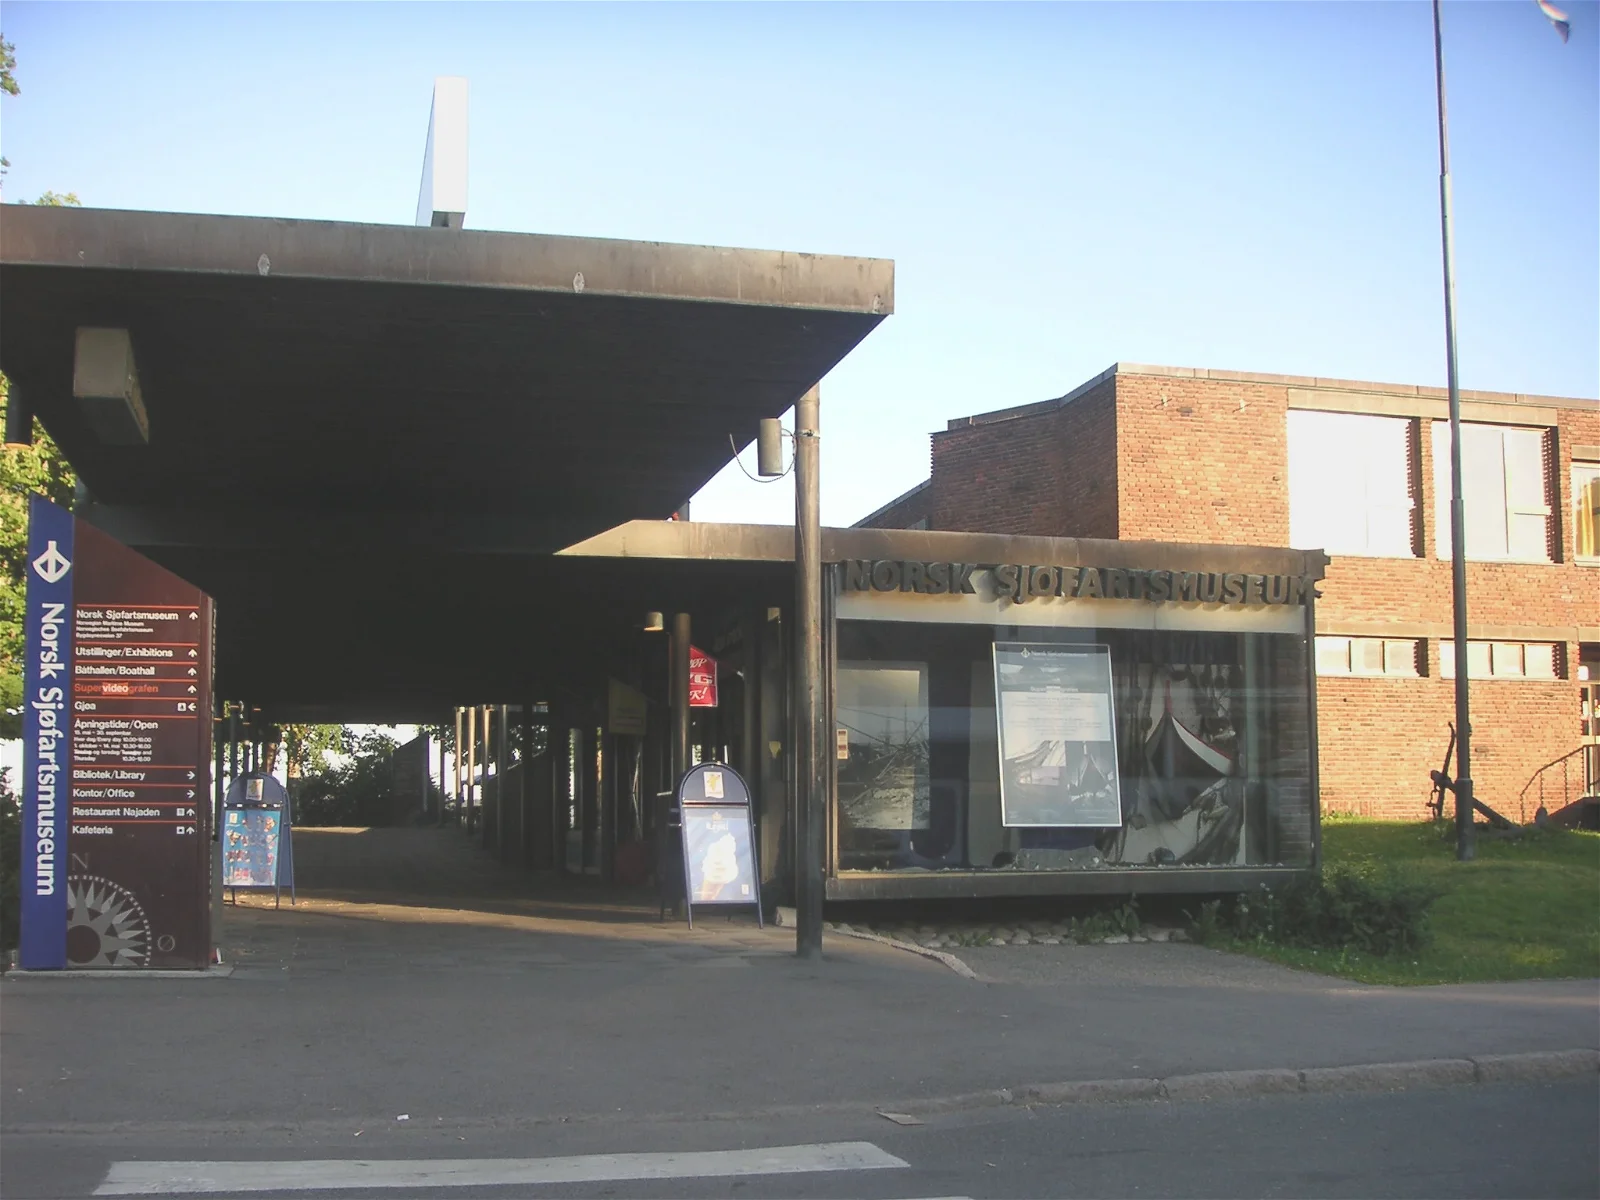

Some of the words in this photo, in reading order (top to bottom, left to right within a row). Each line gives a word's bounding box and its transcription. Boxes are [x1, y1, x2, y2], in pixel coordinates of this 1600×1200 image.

[845, 559, 977, 594] NORSK
[76, 610, 103, 619] Norsk
[40, 603, 65, 679] Norsk
[74, 718, 158, 730] Åpningstider/Open
[73, 770, 145, 780] Bibliotek/Library
[31, 687, 64, 895] Sjøfartsmuseum
[73, 788, 135, 798] Kontor/Office
[73, 807, 120, 816] Restaurant
[123, 808, 160, 817] Najaden
[72, 826, 113, 834] Kafeteria
